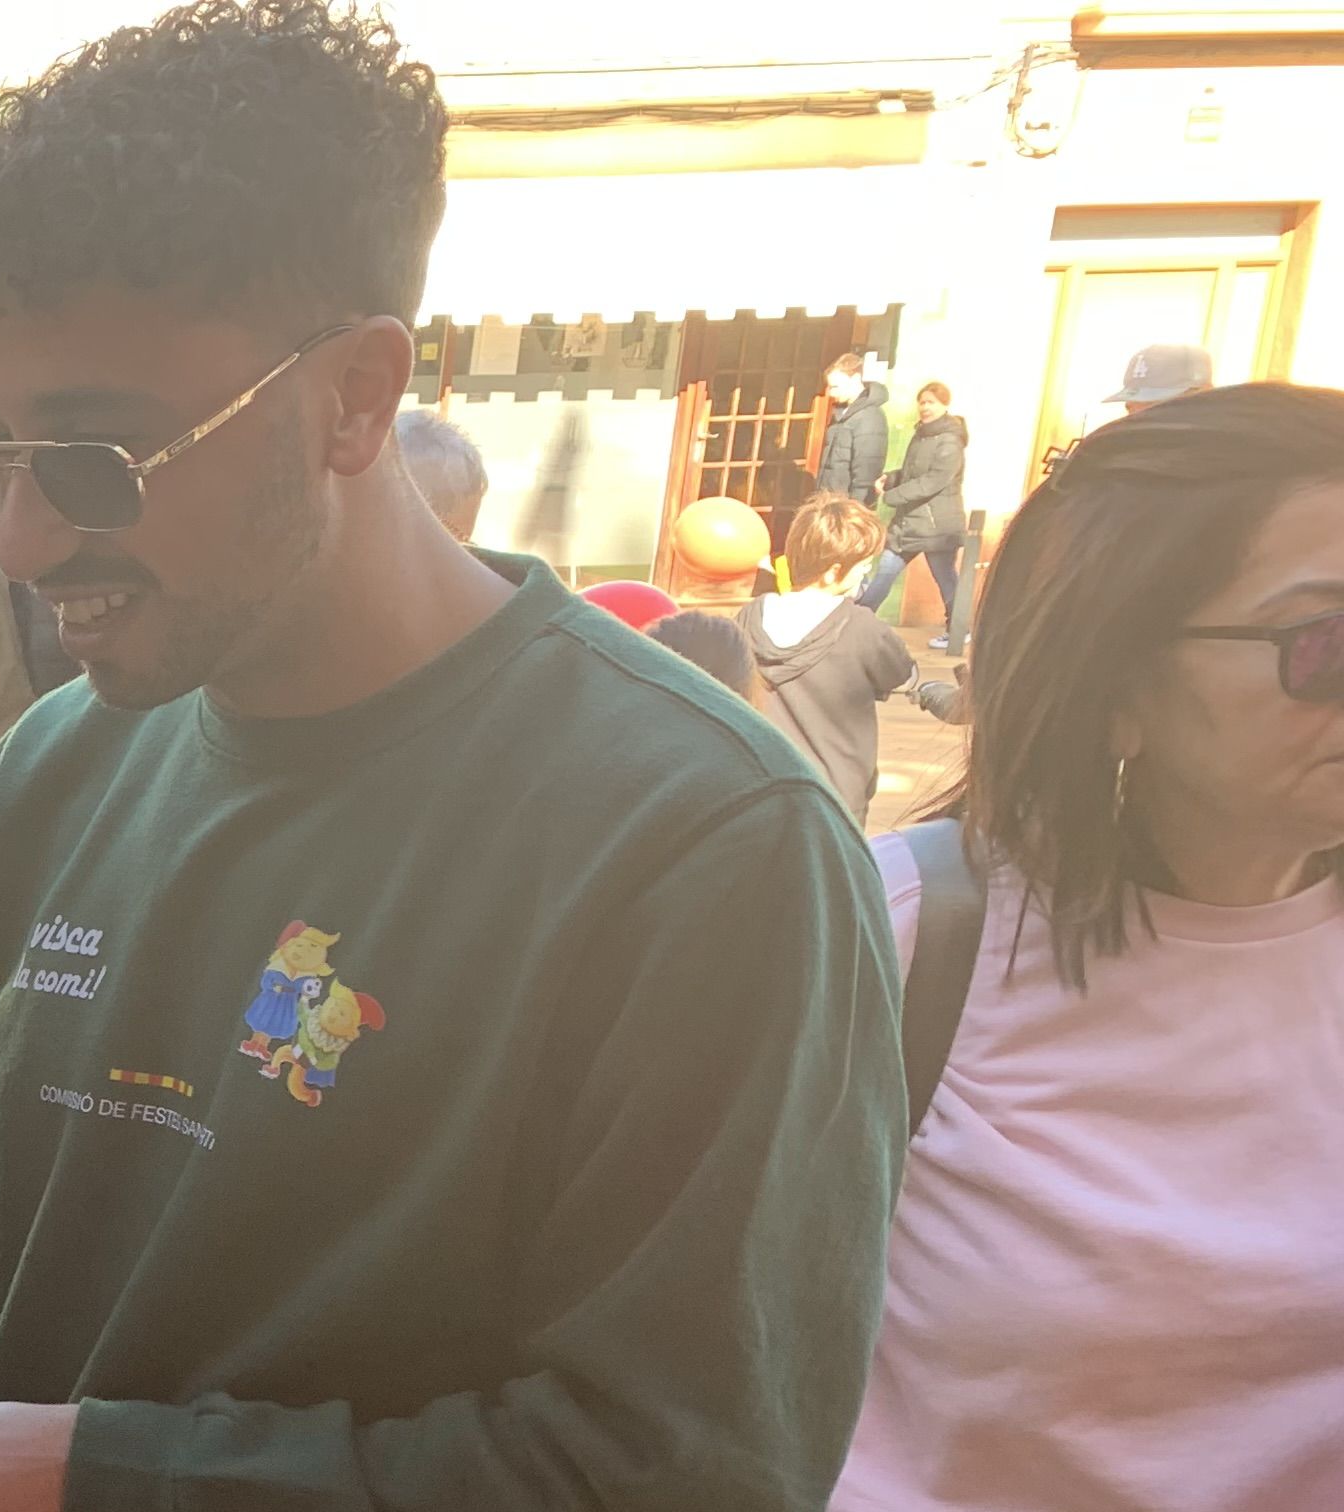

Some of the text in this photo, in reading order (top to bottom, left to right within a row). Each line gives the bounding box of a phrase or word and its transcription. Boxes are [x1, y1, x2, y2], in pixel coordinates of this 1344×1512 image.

[31, 914, 103, 956] visca
[34, 965, 106, 1000] comi!
[99, 1099, 127, 1118] DE
